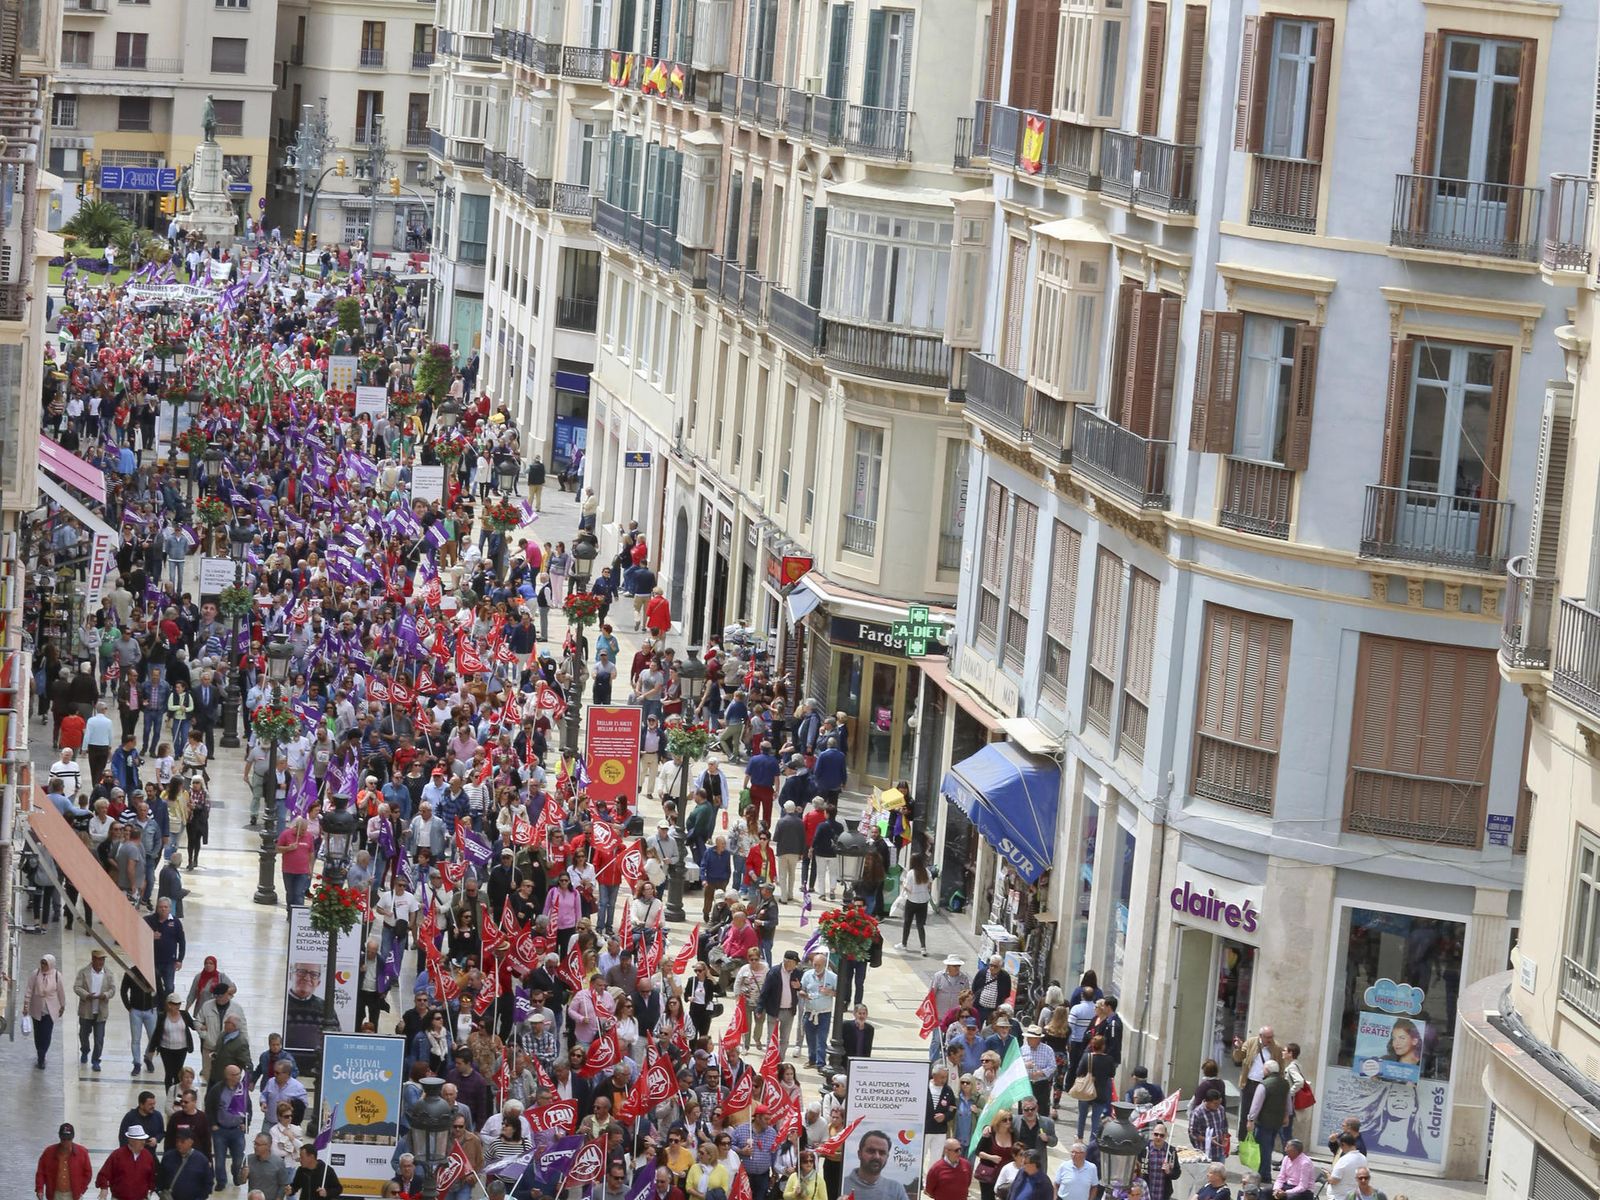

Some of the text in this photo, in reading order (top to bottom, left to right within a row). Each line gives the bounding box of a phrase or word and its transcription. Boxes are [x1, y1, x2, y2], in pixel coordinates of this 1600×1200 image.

[998, 838, 1034, 877] SUR
[1170, 881, 1257, 933] claire's
[346, 1058, 381, 1068] FESTIVAL
[1427, 1087, 1445, 1139] claire's
